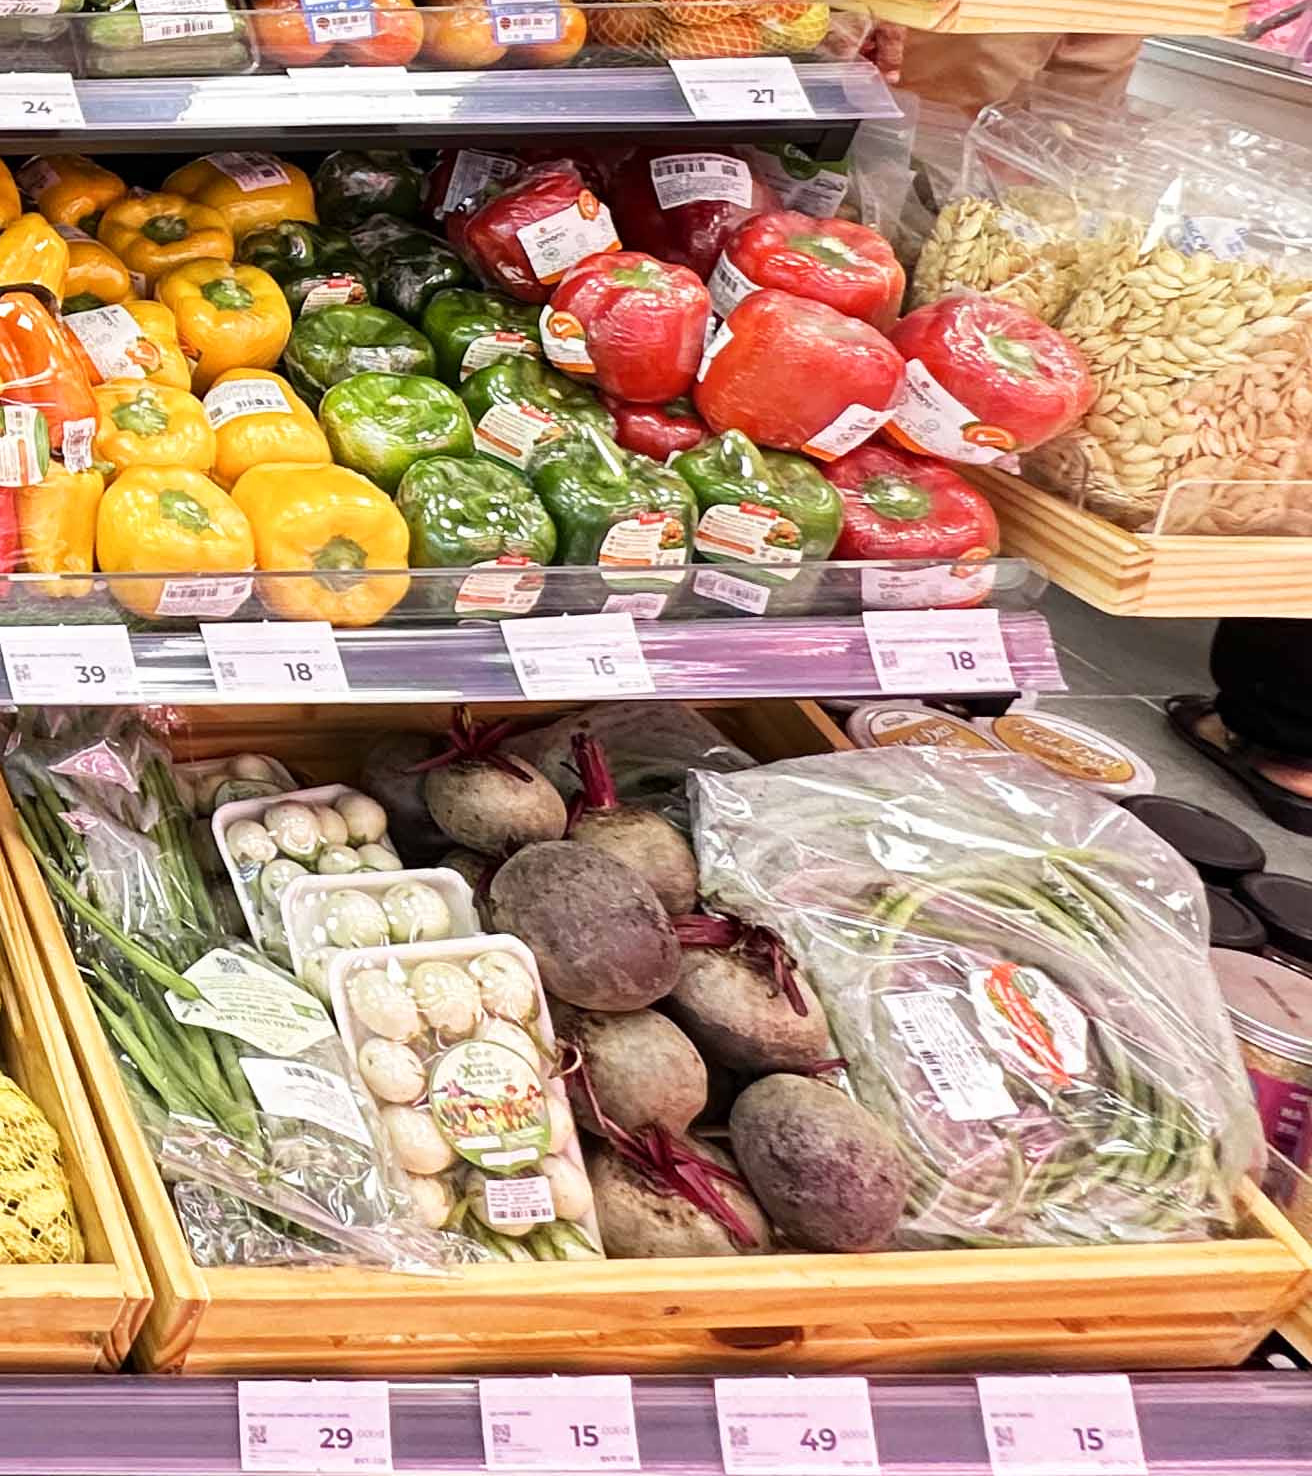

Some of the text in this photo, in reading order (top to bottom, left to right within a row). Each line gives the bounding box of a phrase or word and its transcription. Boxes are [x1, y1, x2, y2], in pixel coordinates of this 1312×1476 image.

[747, 88, 775, 104] 27
[22, 100, 52, 115] 24
[946, 650, 976, 671] 18
[74, 665, 107, 684] 39
[283, 662, 313, 682] 18
[319, 1427, 353, 1450] 29
[569, 1424, 599, 1448] 15
[799, 1427, 837, 1452] 49
[1072, 1427, 1104, 1451] 15
